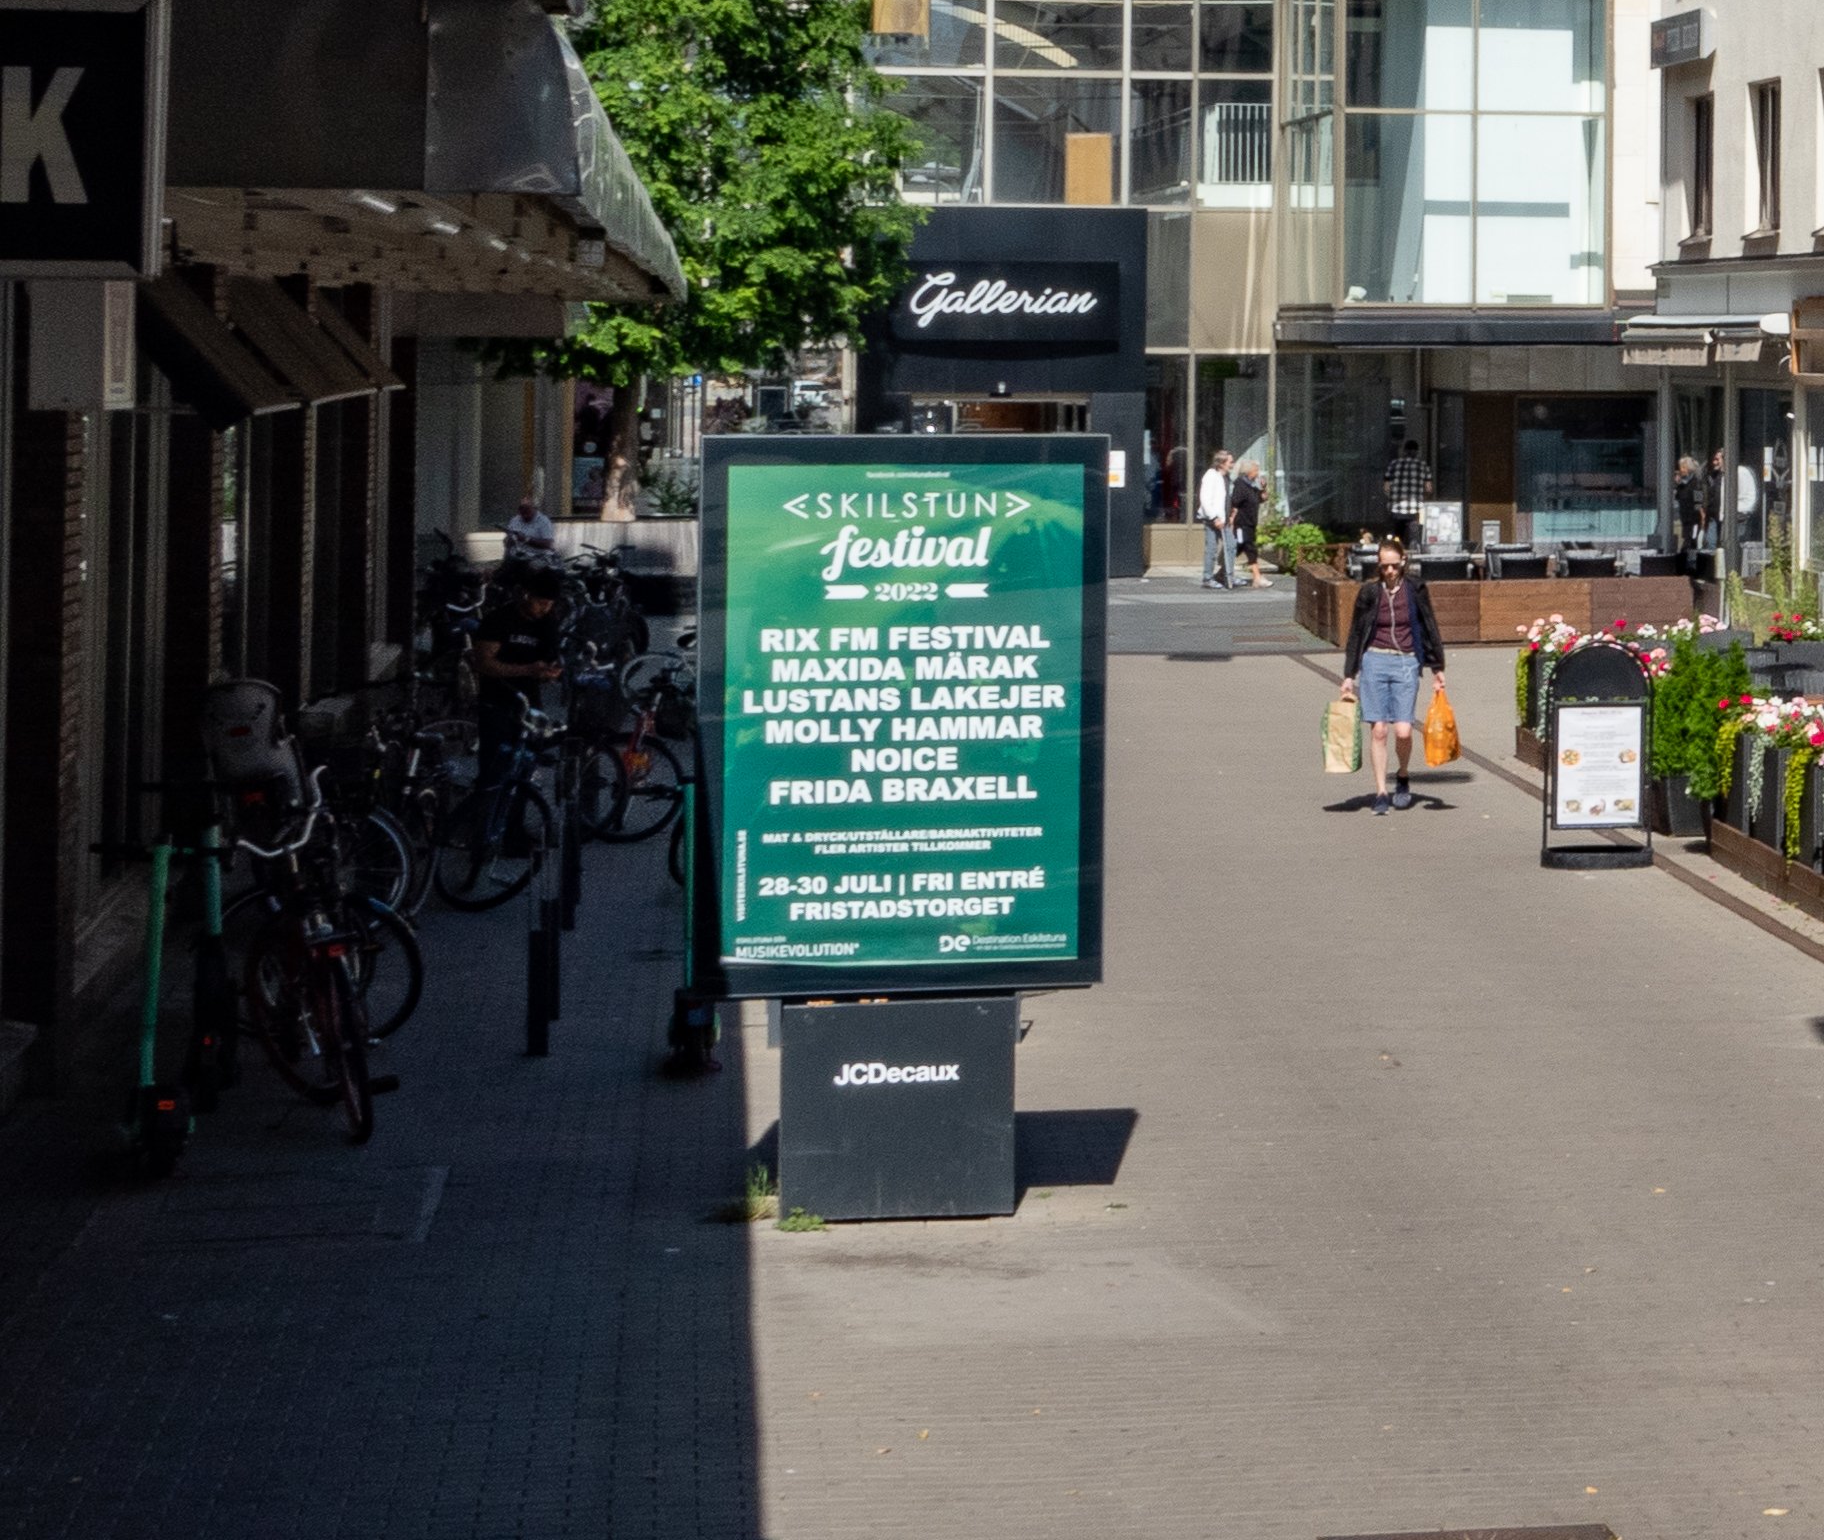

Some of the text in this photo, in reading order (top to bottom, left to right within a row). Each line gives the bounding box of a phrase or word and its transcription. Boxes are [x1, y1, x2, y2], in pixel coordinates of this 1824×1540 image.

[909, 271, 1098, 328] Gallerian
[820, 524, 992, 581] festival
[874, 582, 939, 602] 2022
[761, 625, 1050, 652] RIX FM FESTIVAL
[772, 652, 1038, 682] MAXIDA MÄRAK
[743, 685, 1066, 713] LUSTANS LAKEJER
[765, 715, 1044, 743] MOLLY HAMMAR
[851, 746, 958, 772] NOICE
[769, 775, 1037, 805] FRIDA BRAXELL
[762, 833, 789, 843] MAT
[792, 832, 802, 843] &
[814, 840, 991, 855] FLER ARTISTER TILLKOMMER
[758, 876, 828, 897] 28-30
[833, 874, 892, 895] JULI
[912, 872, 953, 892] FRI
[961, 866, 1045, 891] ENTRÉ
[789, 896, 1015, 921] FRISTADSTORGET
[833, 1062, 960, 1086] JCDecaux
